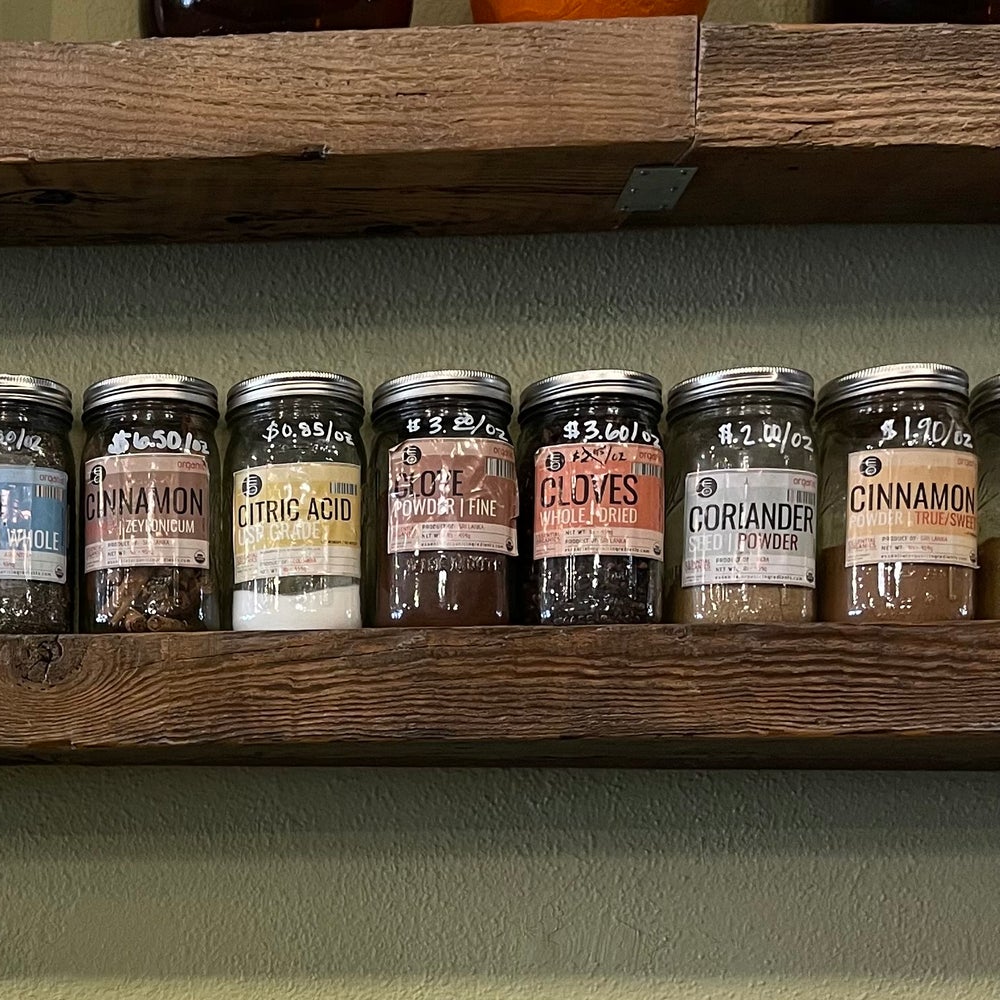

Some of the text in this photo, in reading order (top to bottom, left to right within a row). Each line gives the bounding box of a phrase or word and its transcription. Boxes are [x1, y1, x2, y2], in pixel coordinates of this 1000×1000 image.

[541, 474, 638, 508] CLOVES
[851, 482, 975, 514] CINNAMON
[86, 487, 203, 520] CINNAMON
[239, 498, 350, 527] CITRIC ACID
[393, 499, 496, 517] POWDER FINE
[540, 508, 637, 526] WHOLE DRIED
[689, 503, 813, 534] CORIANDER
[851, 511, 976, 530] POWDER TRUE/SWEET
[7, 529, 59, 550] WHOLE
[270, 522, 320, 540] GRADE
[689, 533, 798, 552] SEED POWDER
